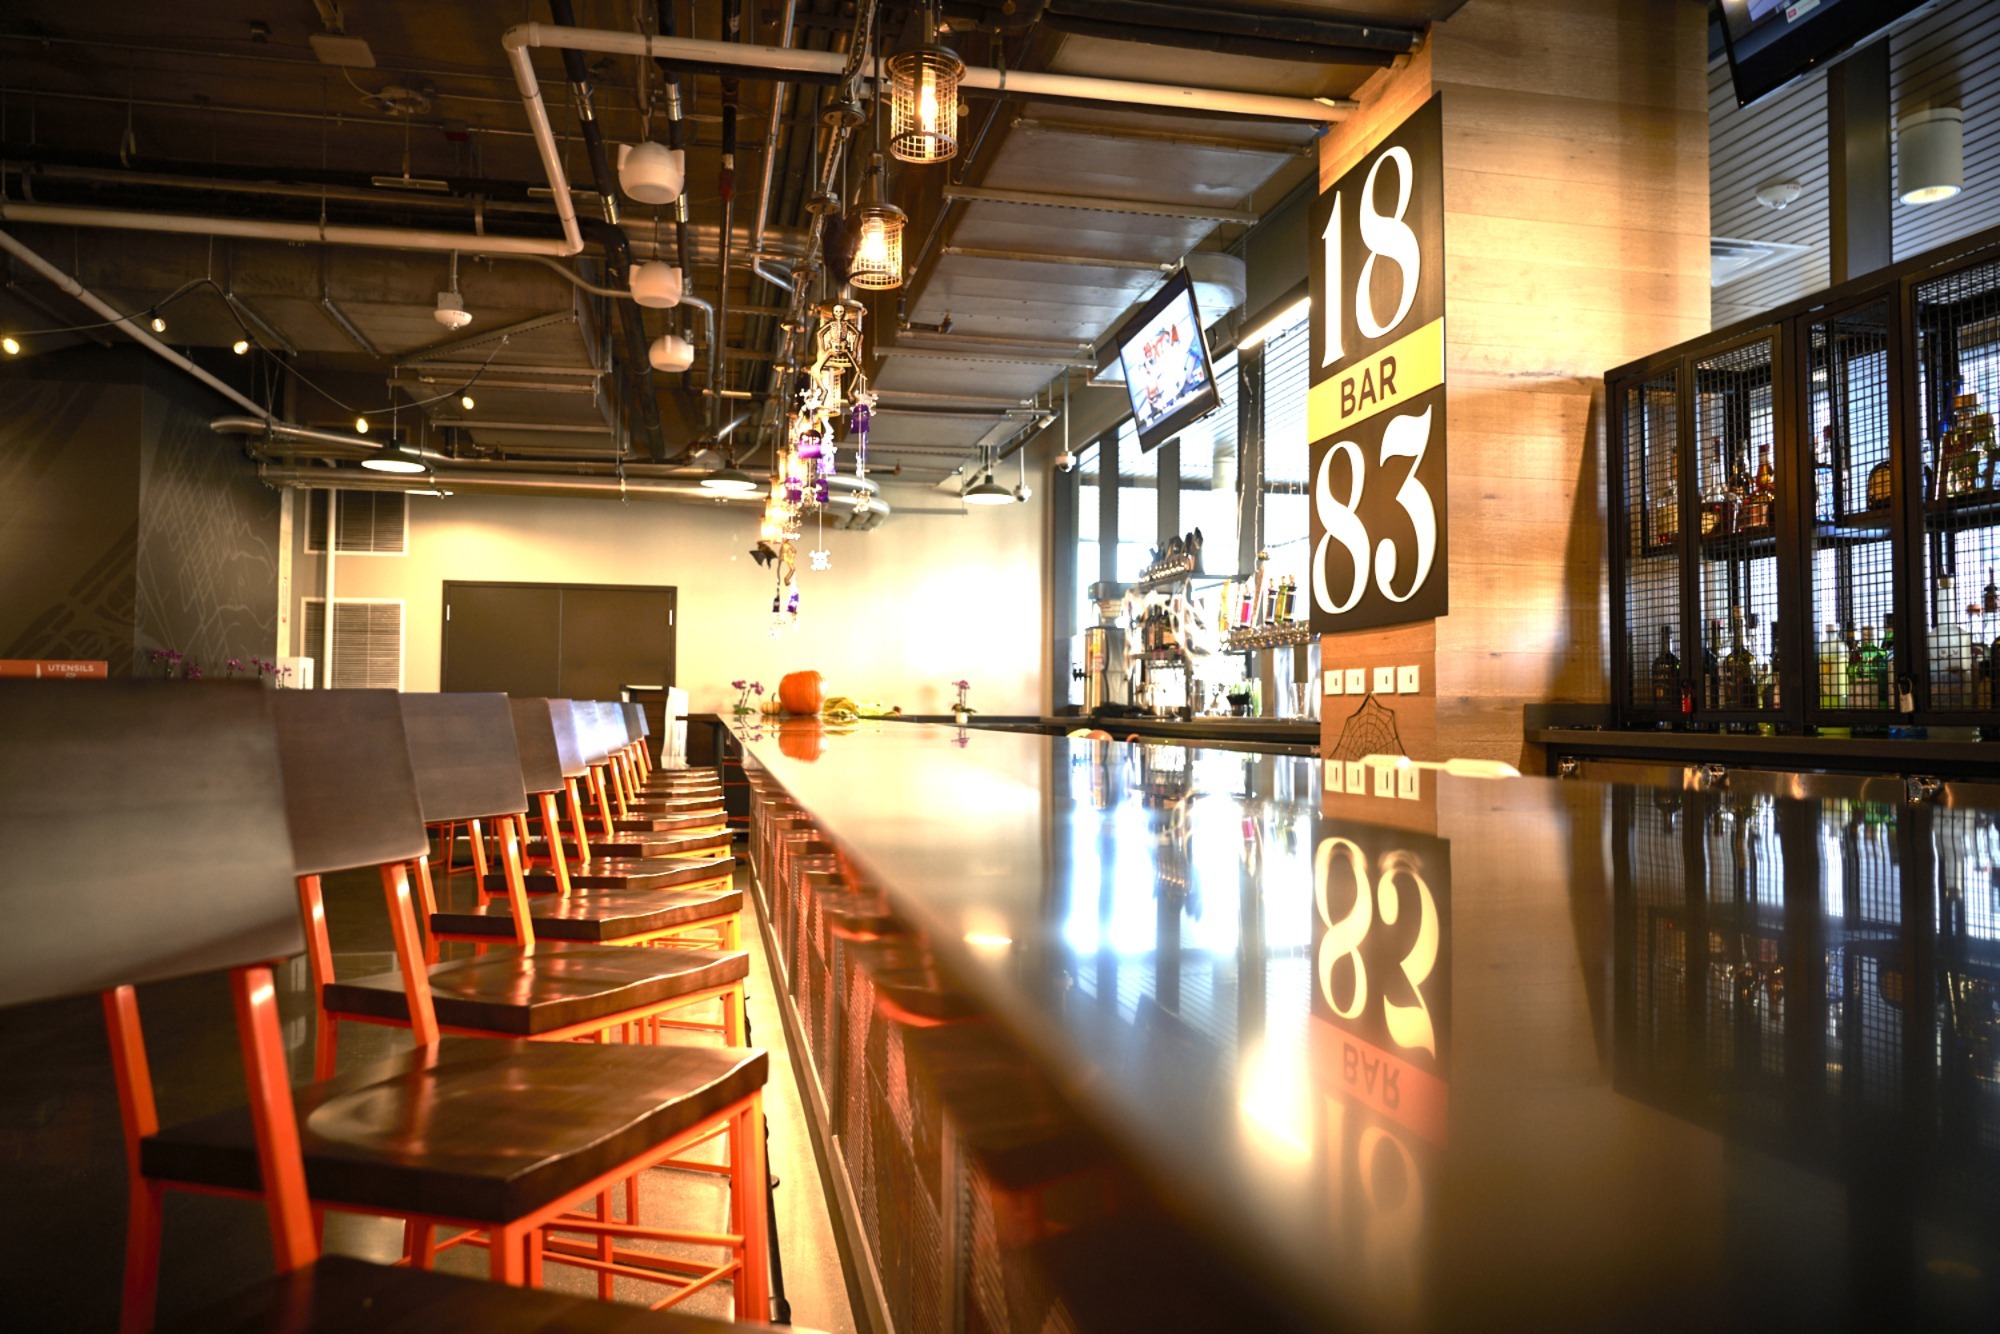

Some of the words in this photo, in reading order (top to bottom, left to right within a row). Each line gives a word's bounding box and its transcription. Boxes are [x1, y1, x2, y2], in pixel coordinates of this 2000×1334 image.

[1321, 146, 1421, 369] 18
[1340, 355, 1398, 420] BAR
[1312, 404, 1437, 615] 83
[48, 664, 95, 672] UTENSILS
